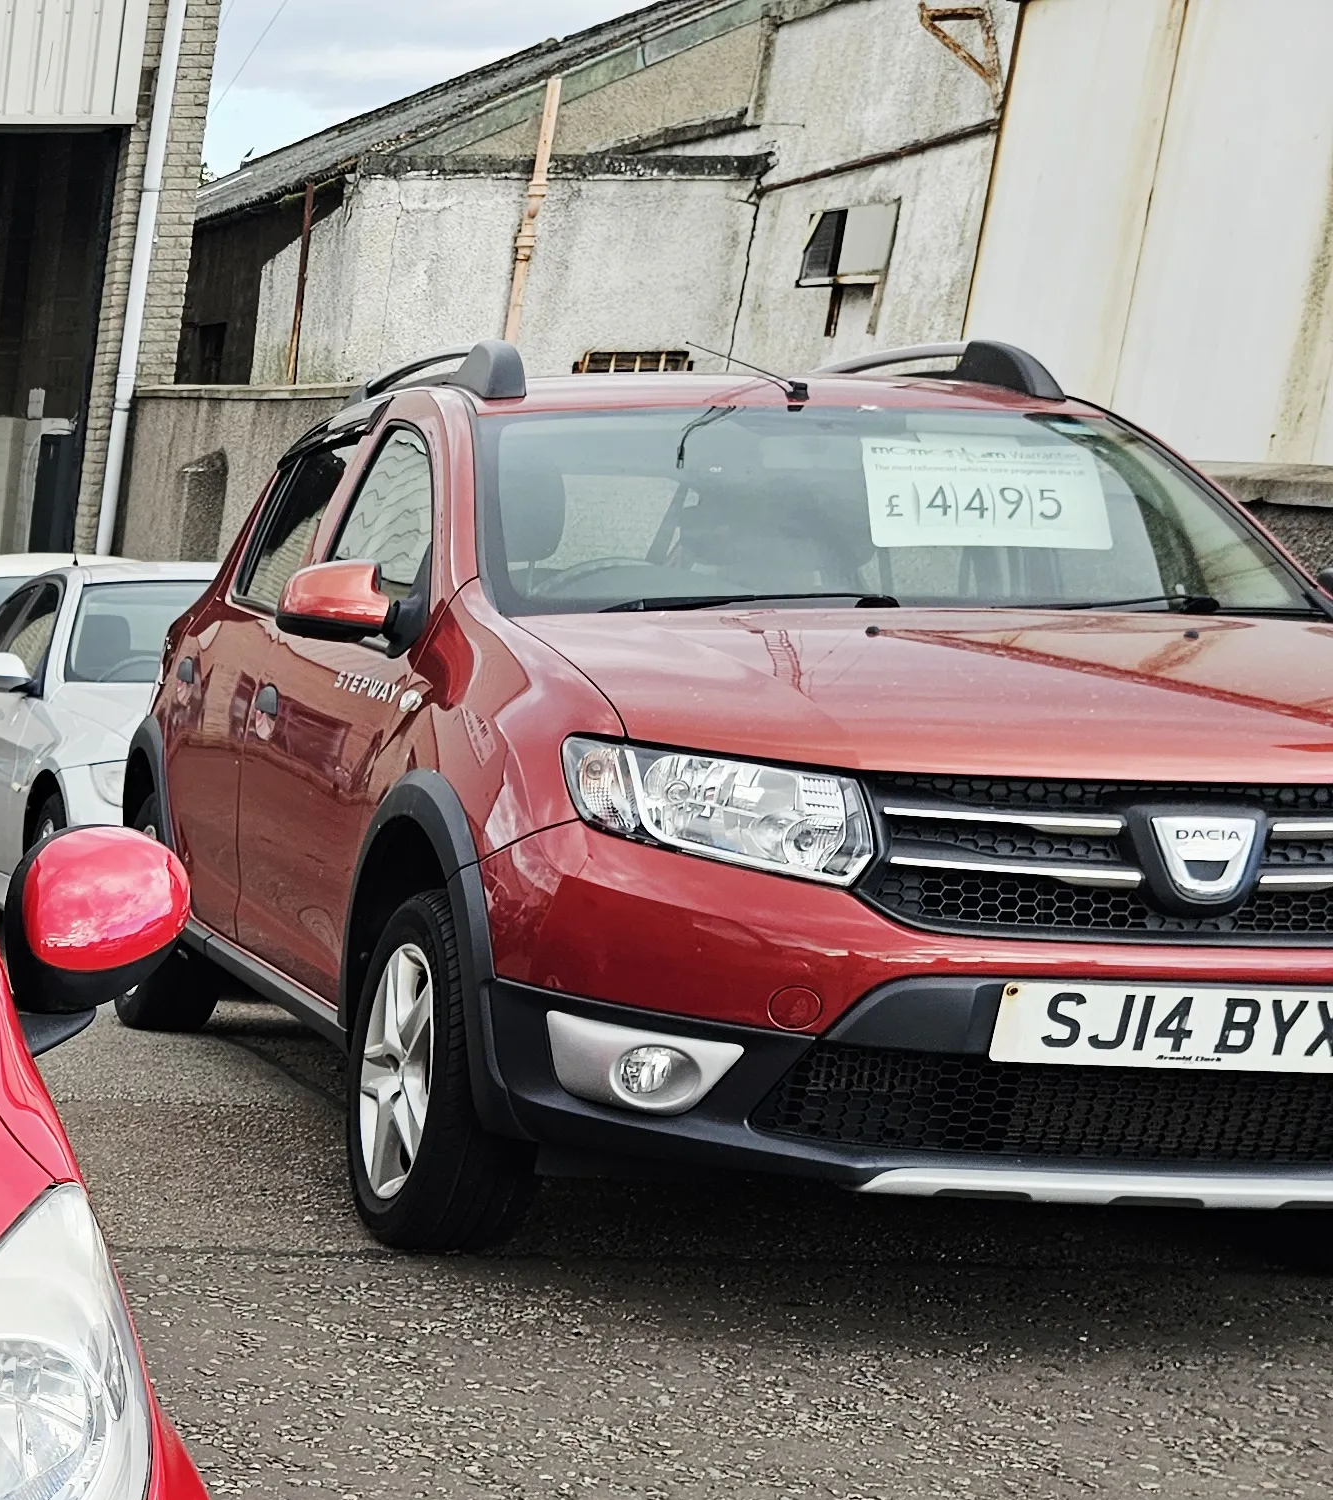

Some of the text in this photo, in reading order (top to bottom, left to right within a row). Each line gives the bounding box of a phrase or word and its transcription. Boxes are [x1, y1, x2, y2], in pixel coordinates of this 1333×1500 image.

[334, 670, 401, 703] STEPWAY
[1175, 829, 1241, 841] DACIA
[1041, 992, 1194, 1052] SJ14
